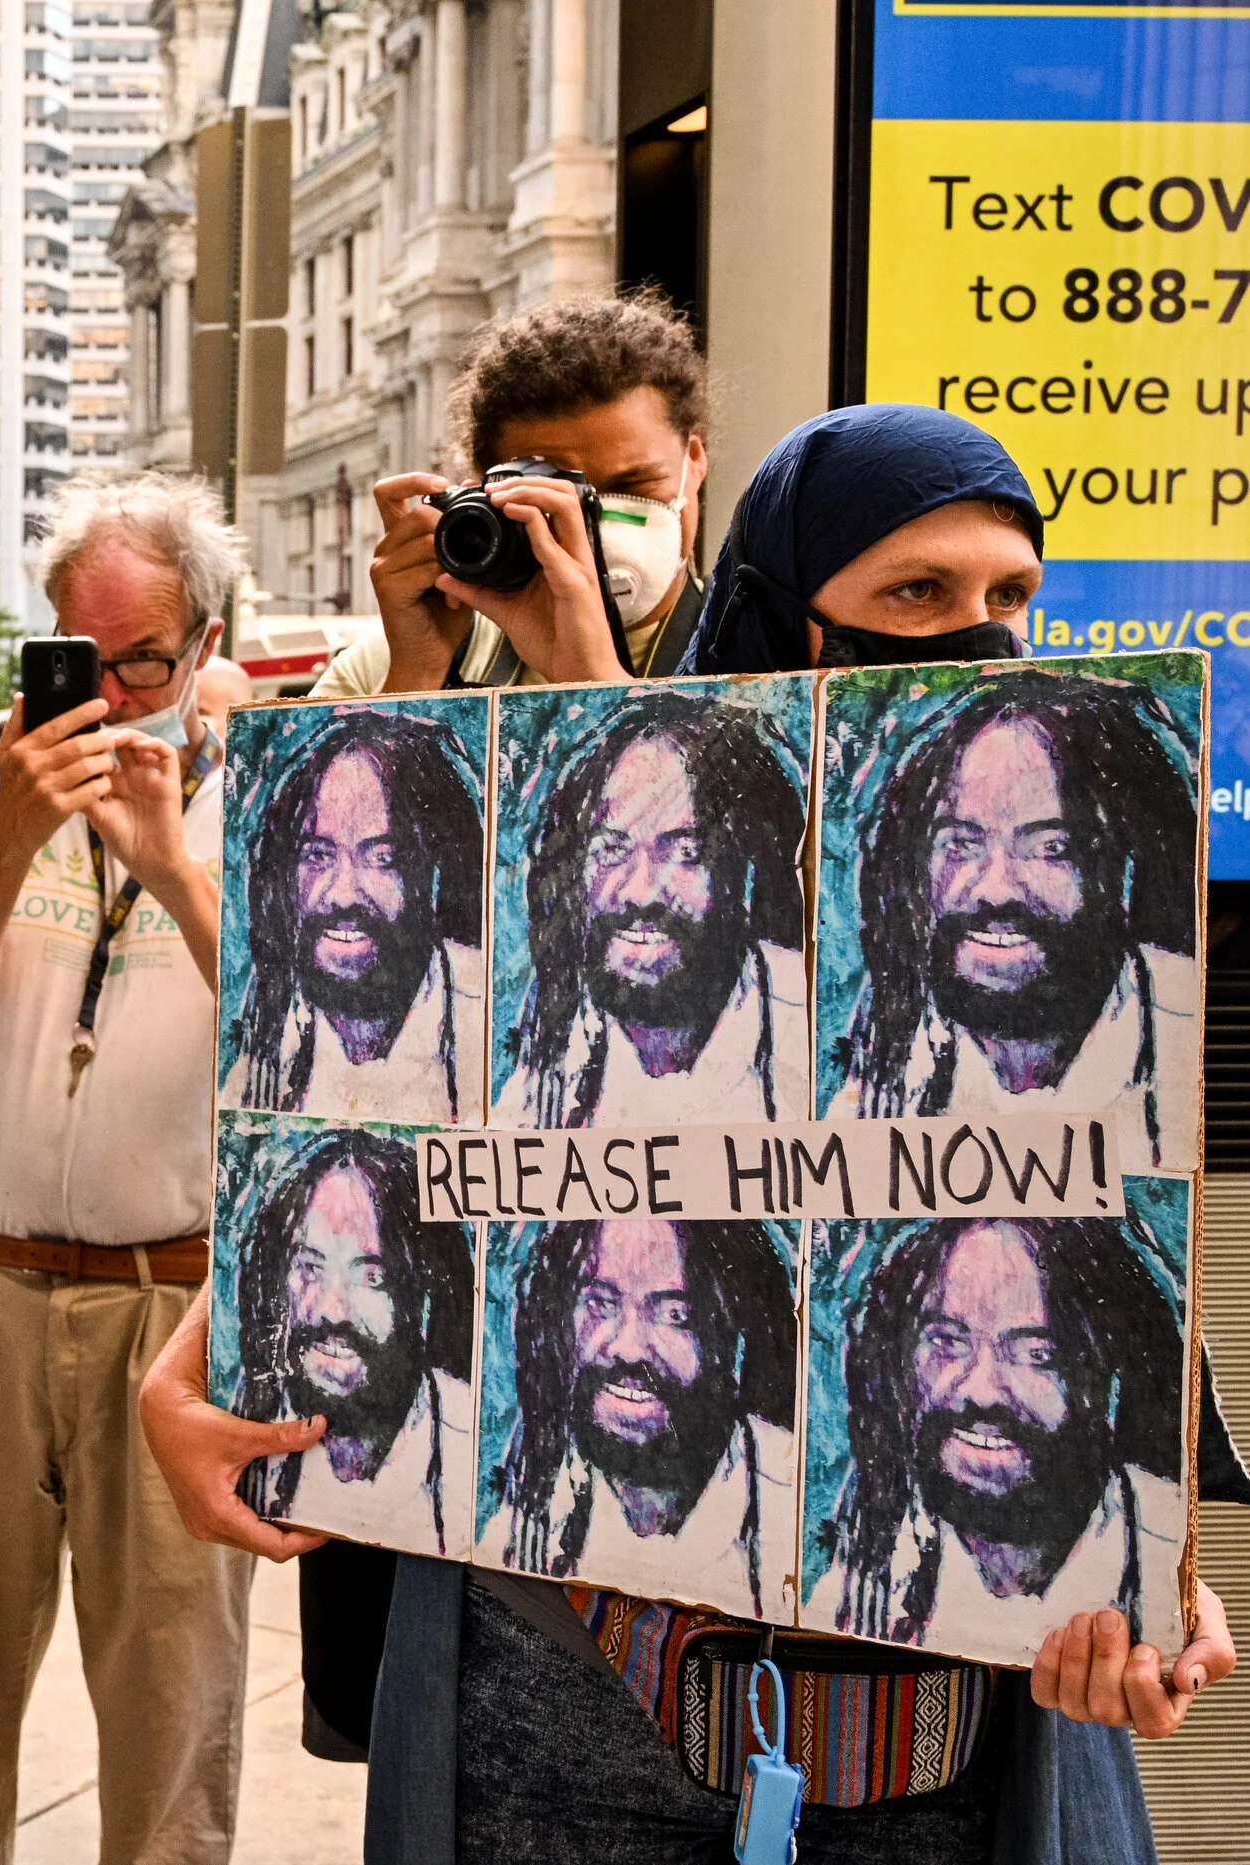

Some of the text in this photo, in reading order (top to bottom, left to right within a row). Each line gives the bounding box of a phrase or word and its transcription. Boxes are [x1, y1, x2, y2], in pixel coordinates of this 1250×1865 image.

[929, 175, 1250, 233] Text COV
[969, 267, 1250, 323] to 888-7
[938, 360, 1170, 414] receive
[1043, 467, 1250, 526] your p
[1026, 608, 1250, 654] la.gov/CO
[12, 896, 95, 933] OVE
[426, 1120, 1108, 1219] RELEASE HIM NOW!
